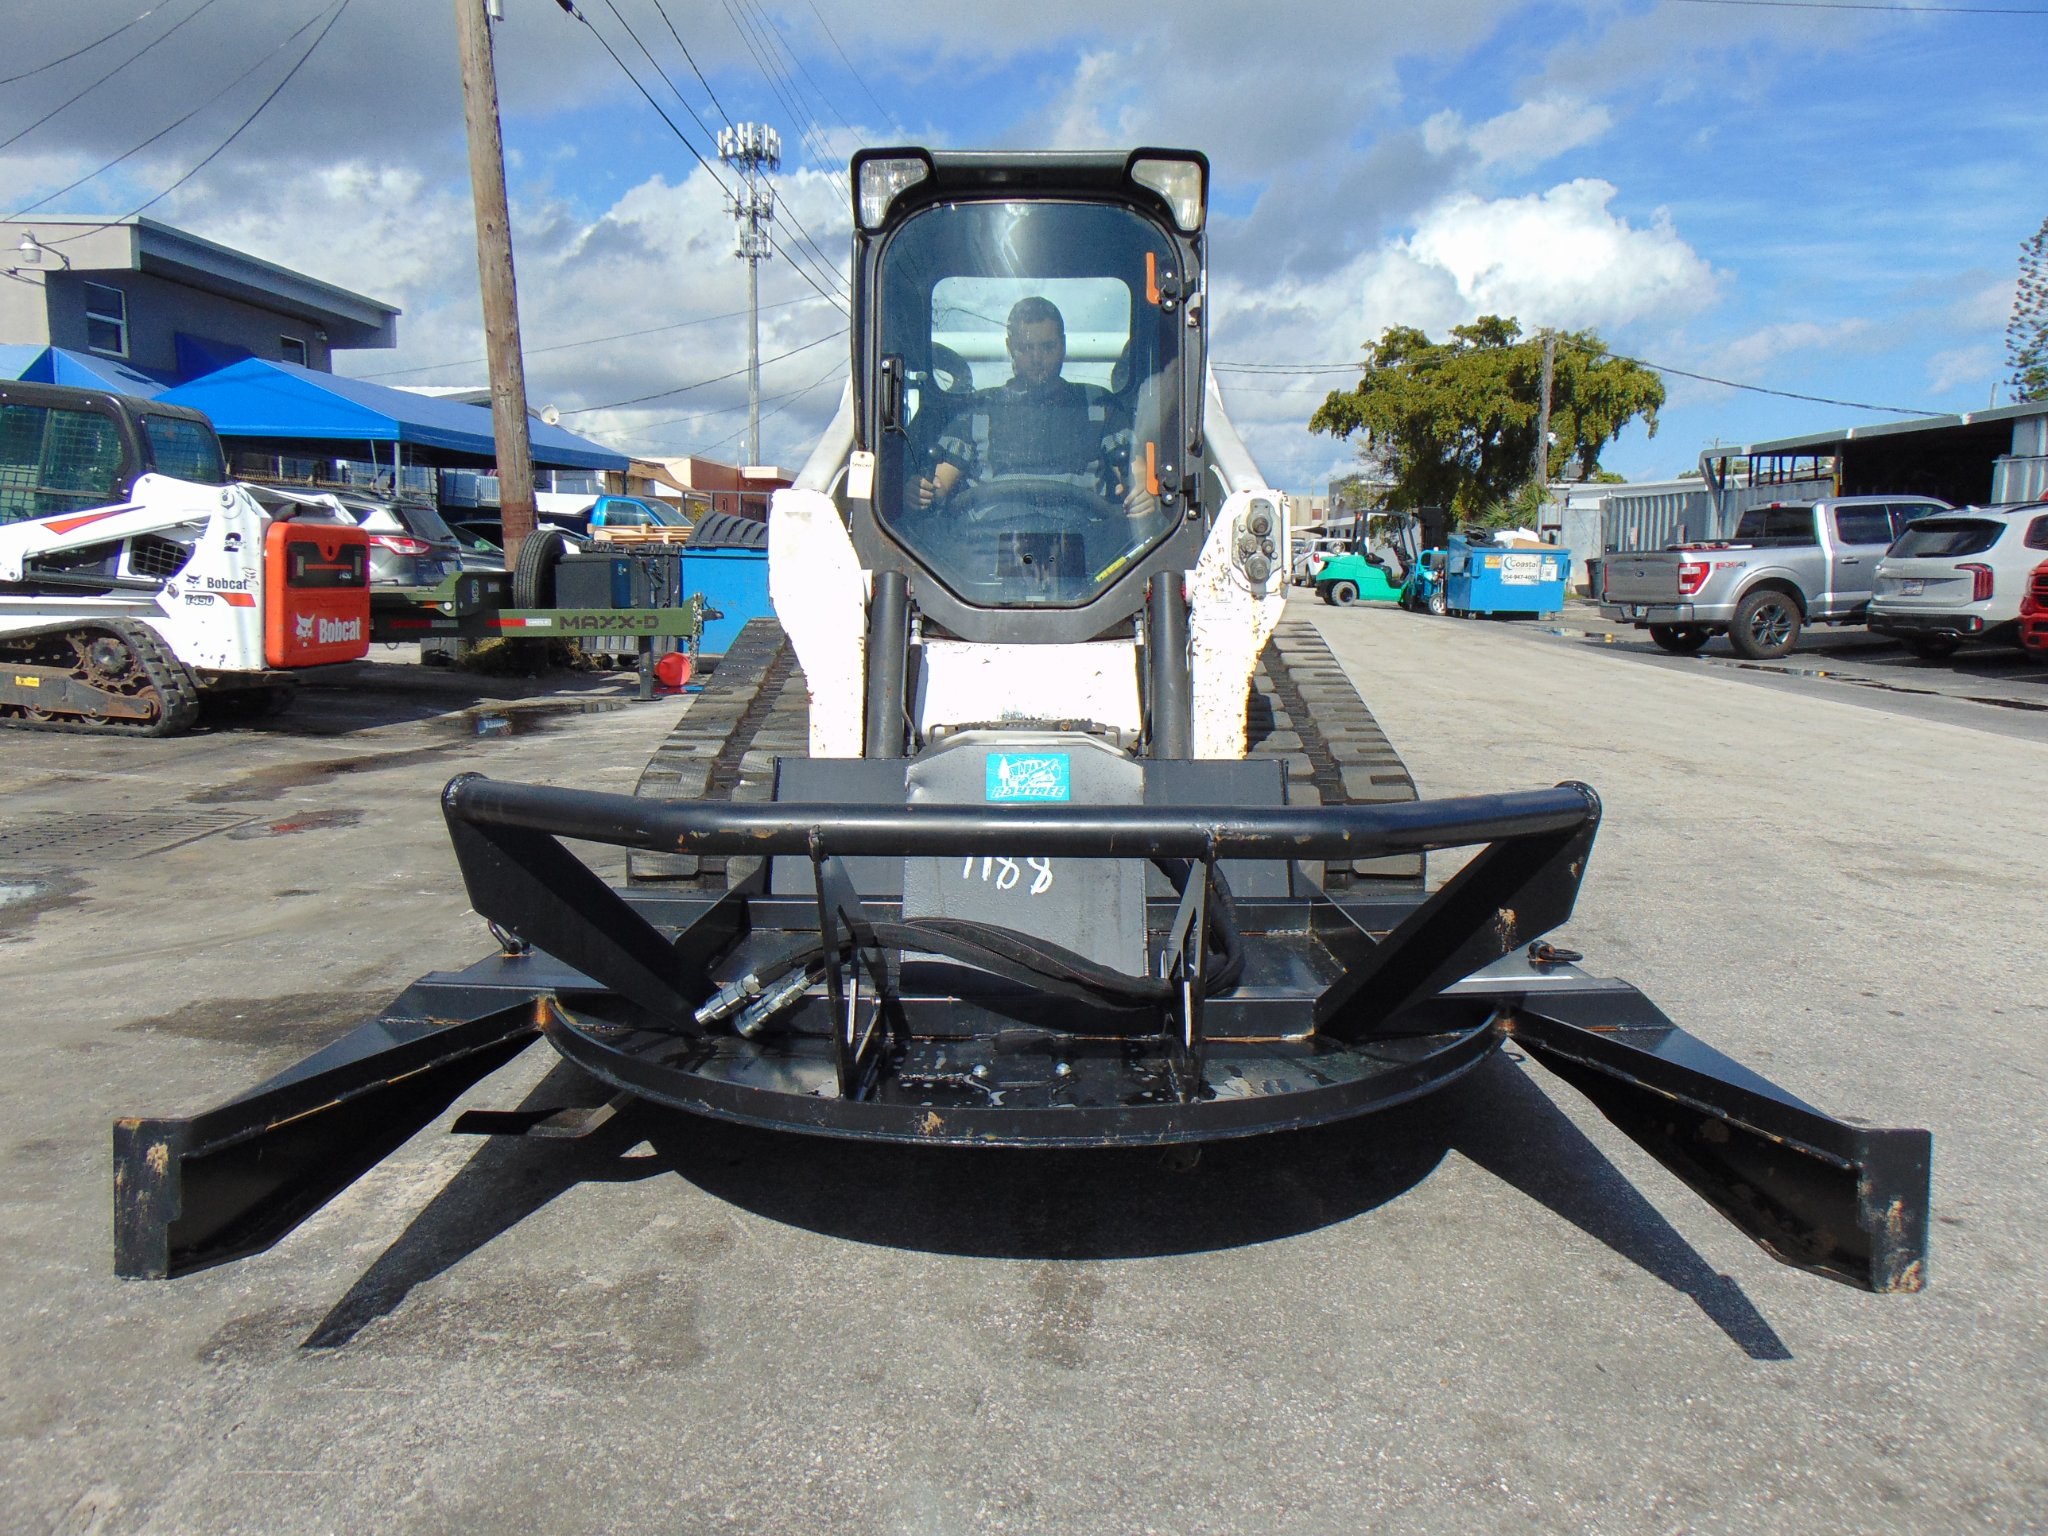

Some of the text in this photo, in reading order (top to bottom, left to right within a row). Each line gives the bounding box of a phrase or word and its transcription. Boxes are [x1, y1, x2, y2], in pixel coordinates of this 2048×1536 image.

[1510, 560, 1539, 568] Coastal
[207, 577, 247, 590] Bobcat
[185, 594, 214, 606] T450
[559, 615, 660, 630] MAXX-D
[319, 617, 360, 643] Bobcat
